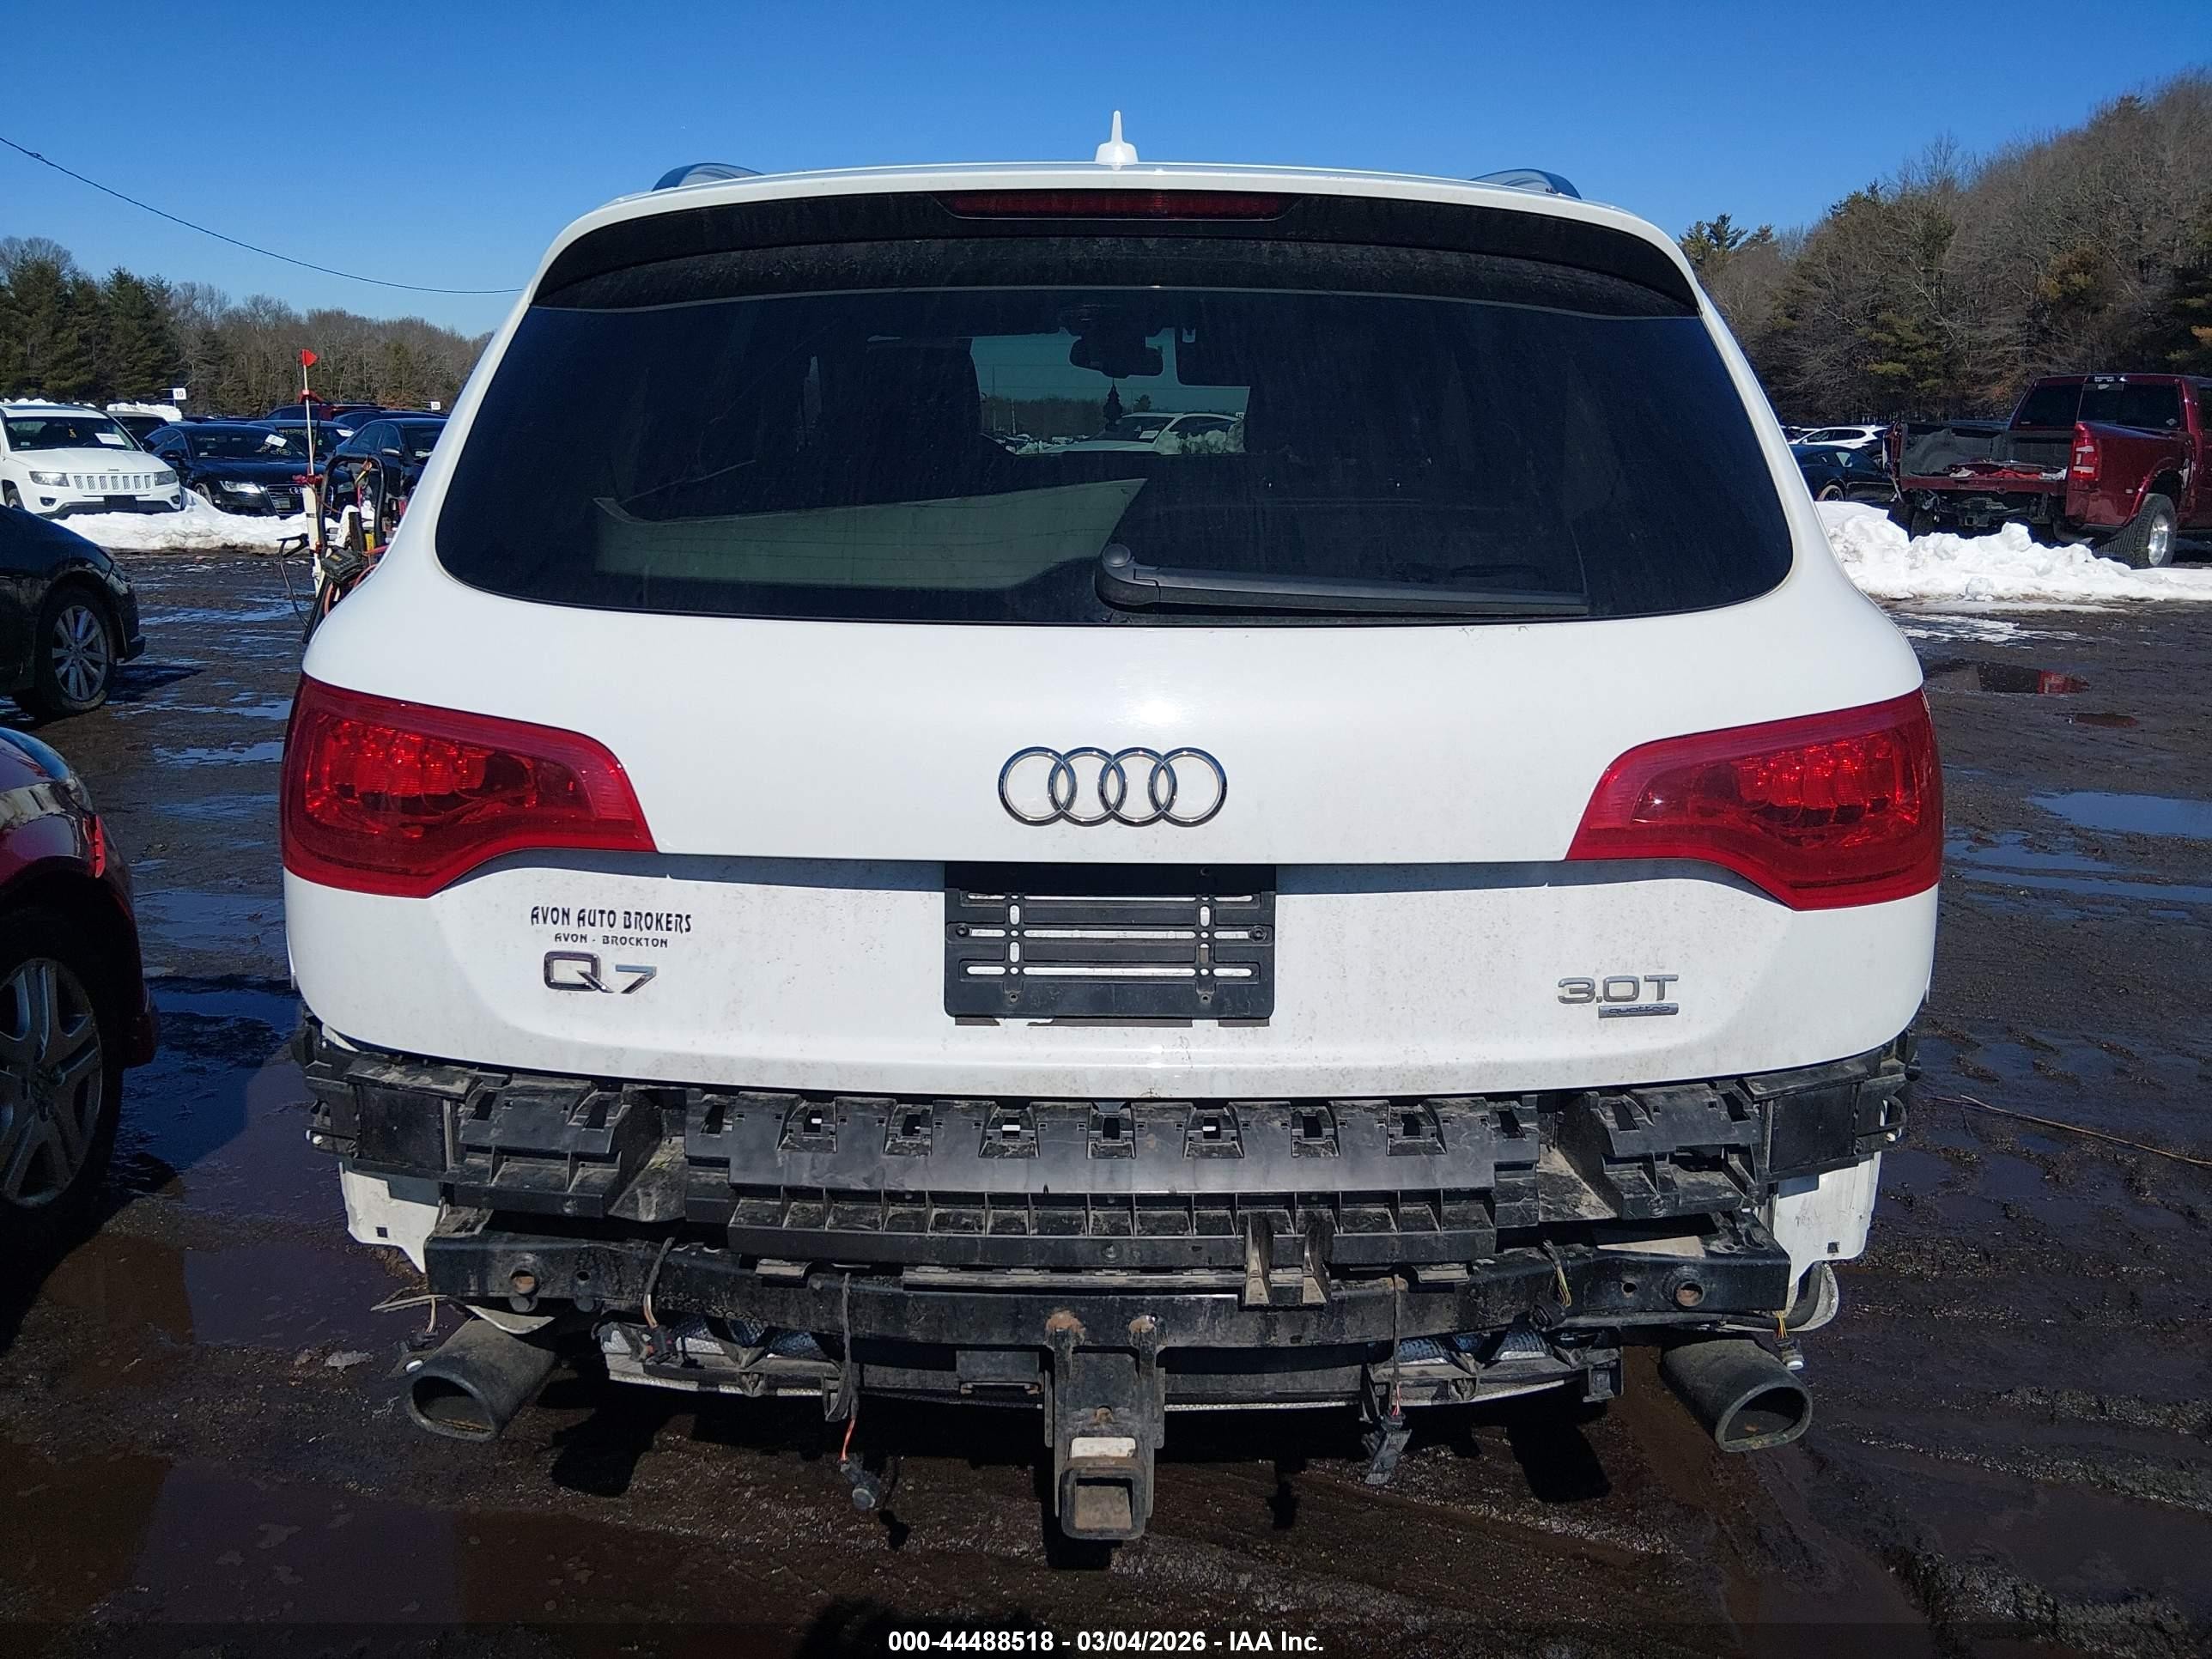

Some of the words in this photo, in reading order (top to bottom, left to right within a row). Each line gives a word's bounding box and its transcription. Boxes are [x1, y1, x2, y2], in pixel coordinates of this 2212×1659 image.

[531, 906, 570, 927] AVON
[577, 908, 617, 928] AUTO
[623, 910, 692, 933] BROKERS
[554, 933, 587, 944] AVON
[602, 934, 668, 948] BROCKTON
[544, 951, 657, 994] Q7
[1558, 975, 1679, 1004] 3.0T
[1609, 1006, 1670, 1014] quattro
